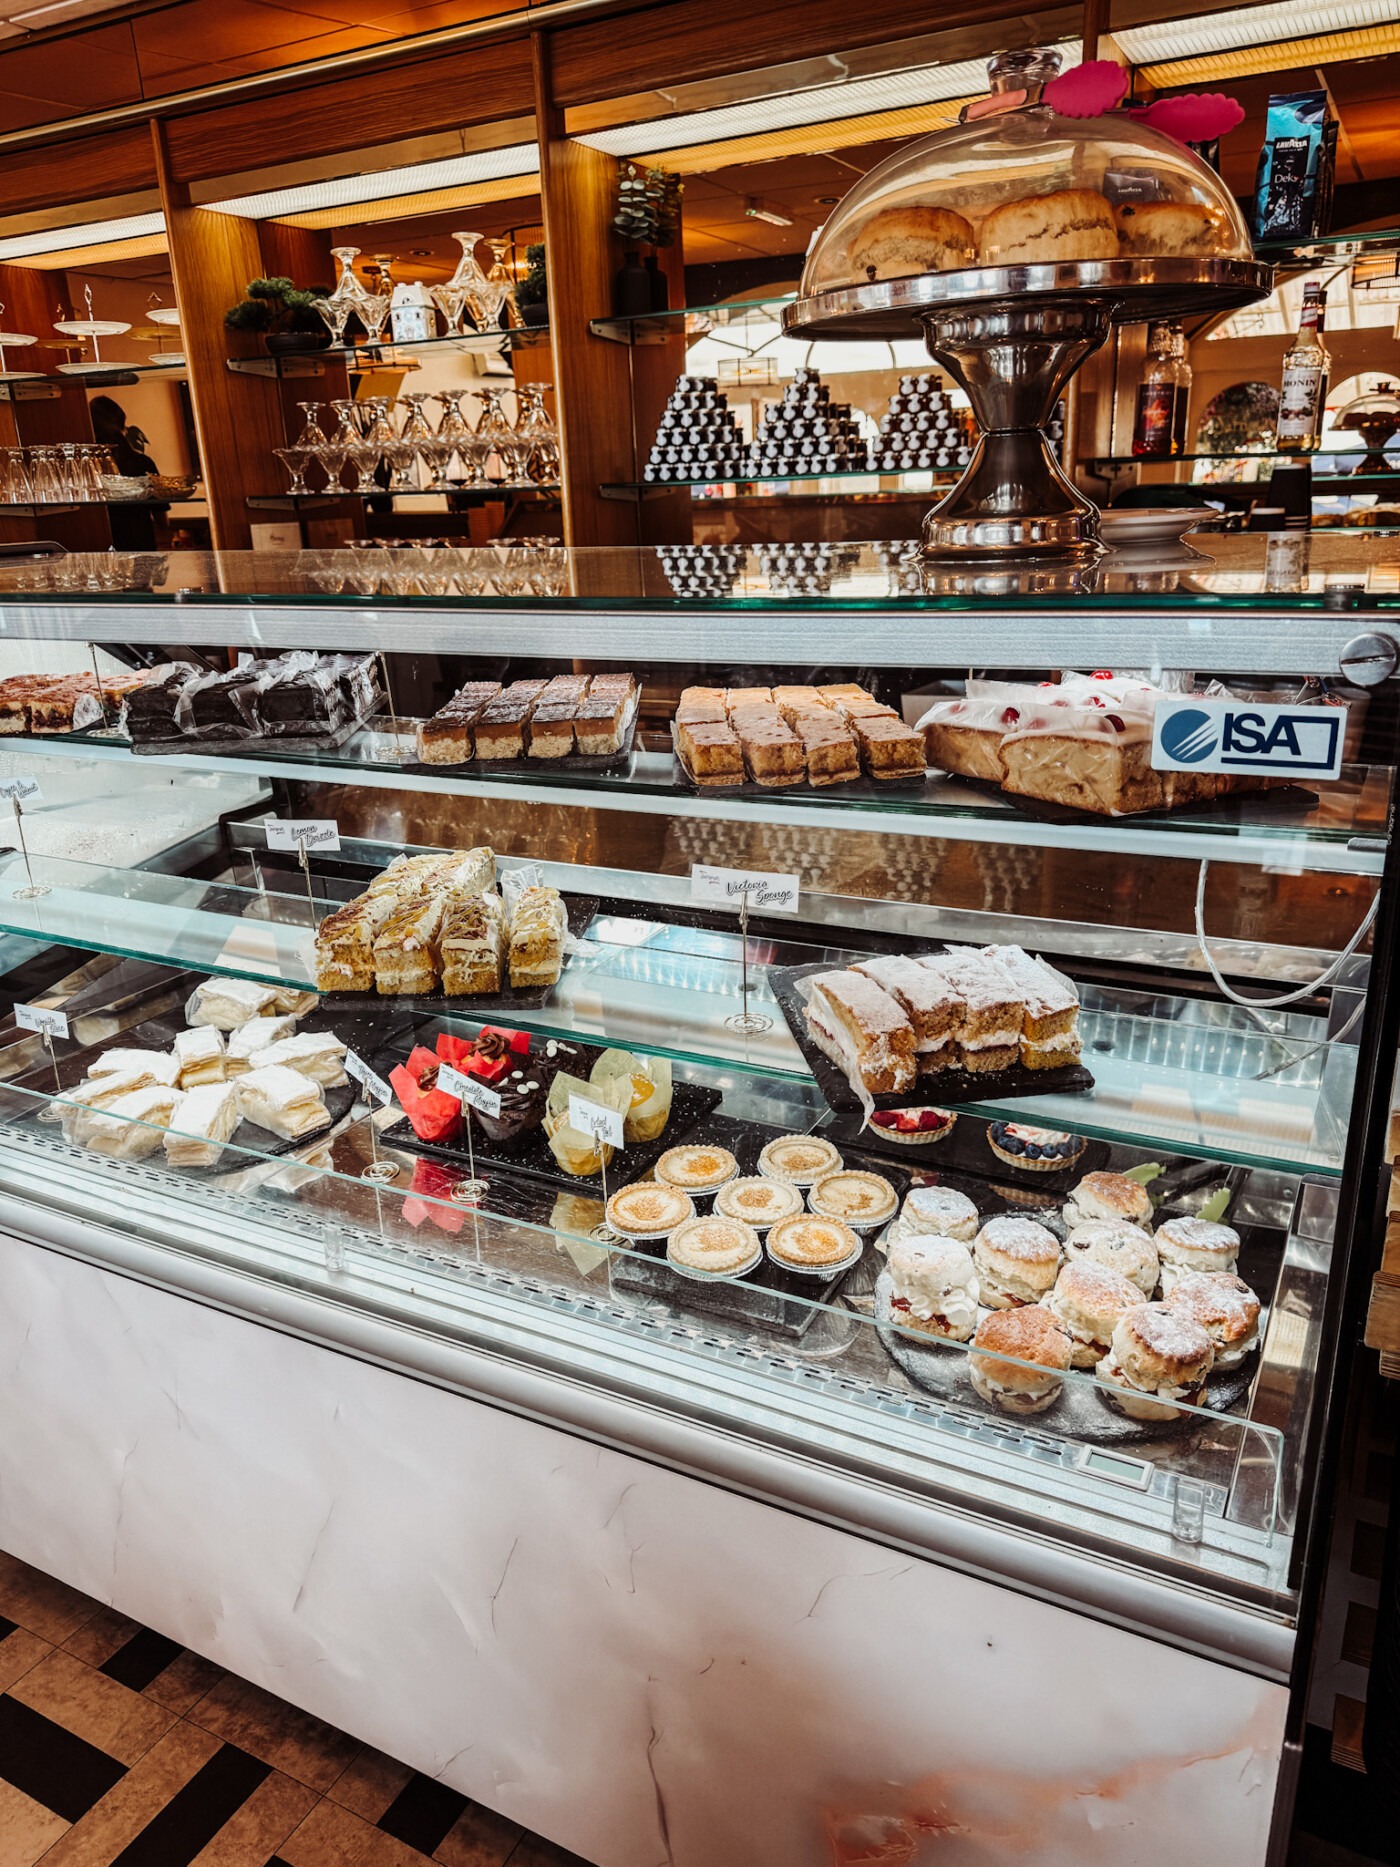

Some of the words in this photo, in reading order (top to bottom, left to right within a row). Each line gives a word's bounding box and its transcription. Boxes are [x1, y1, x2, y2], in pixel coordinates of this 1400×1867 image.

[1276, 138, 1307, 149] LAVAZZA
[1221, 712, 1303, 757] ISA
[291, 825, 318, 842] Lemon
[726, 880, 769, 897] Victoria
[755, 888, 795, 906] Sponge
